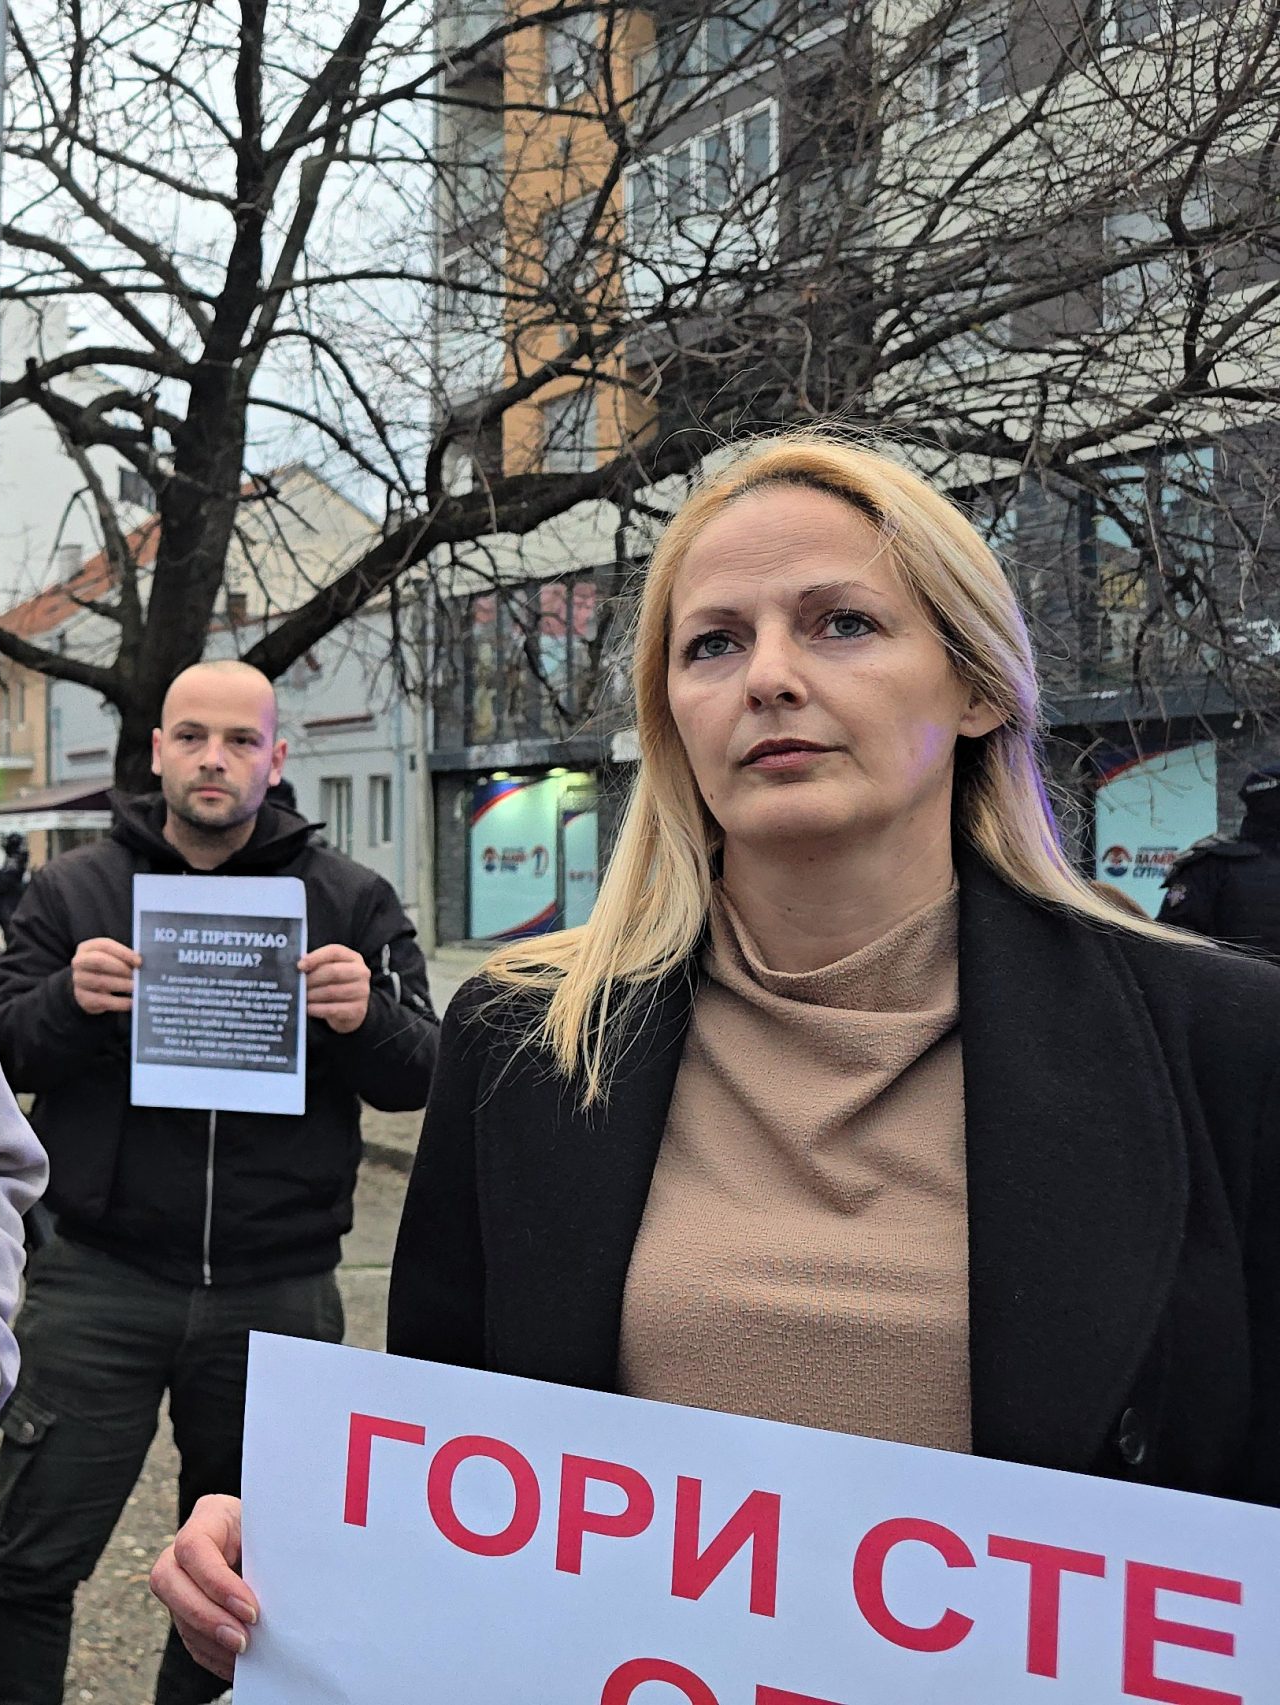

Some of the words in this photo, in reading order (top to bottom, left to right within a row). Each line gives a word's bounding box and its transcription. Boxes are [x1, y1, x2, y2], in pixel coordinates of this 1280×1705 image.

[154, 927, 177, 942] КО
[180, 928, 199, 944] ЈЕ
[201, 929, 288, 949] ПРЕТУКАО
[177, 949, 263, 968] МИЛОША?
[343, 1412, 781, 1618] ГОРИ
[852, 1516, 1244, 1705] СТЕ
